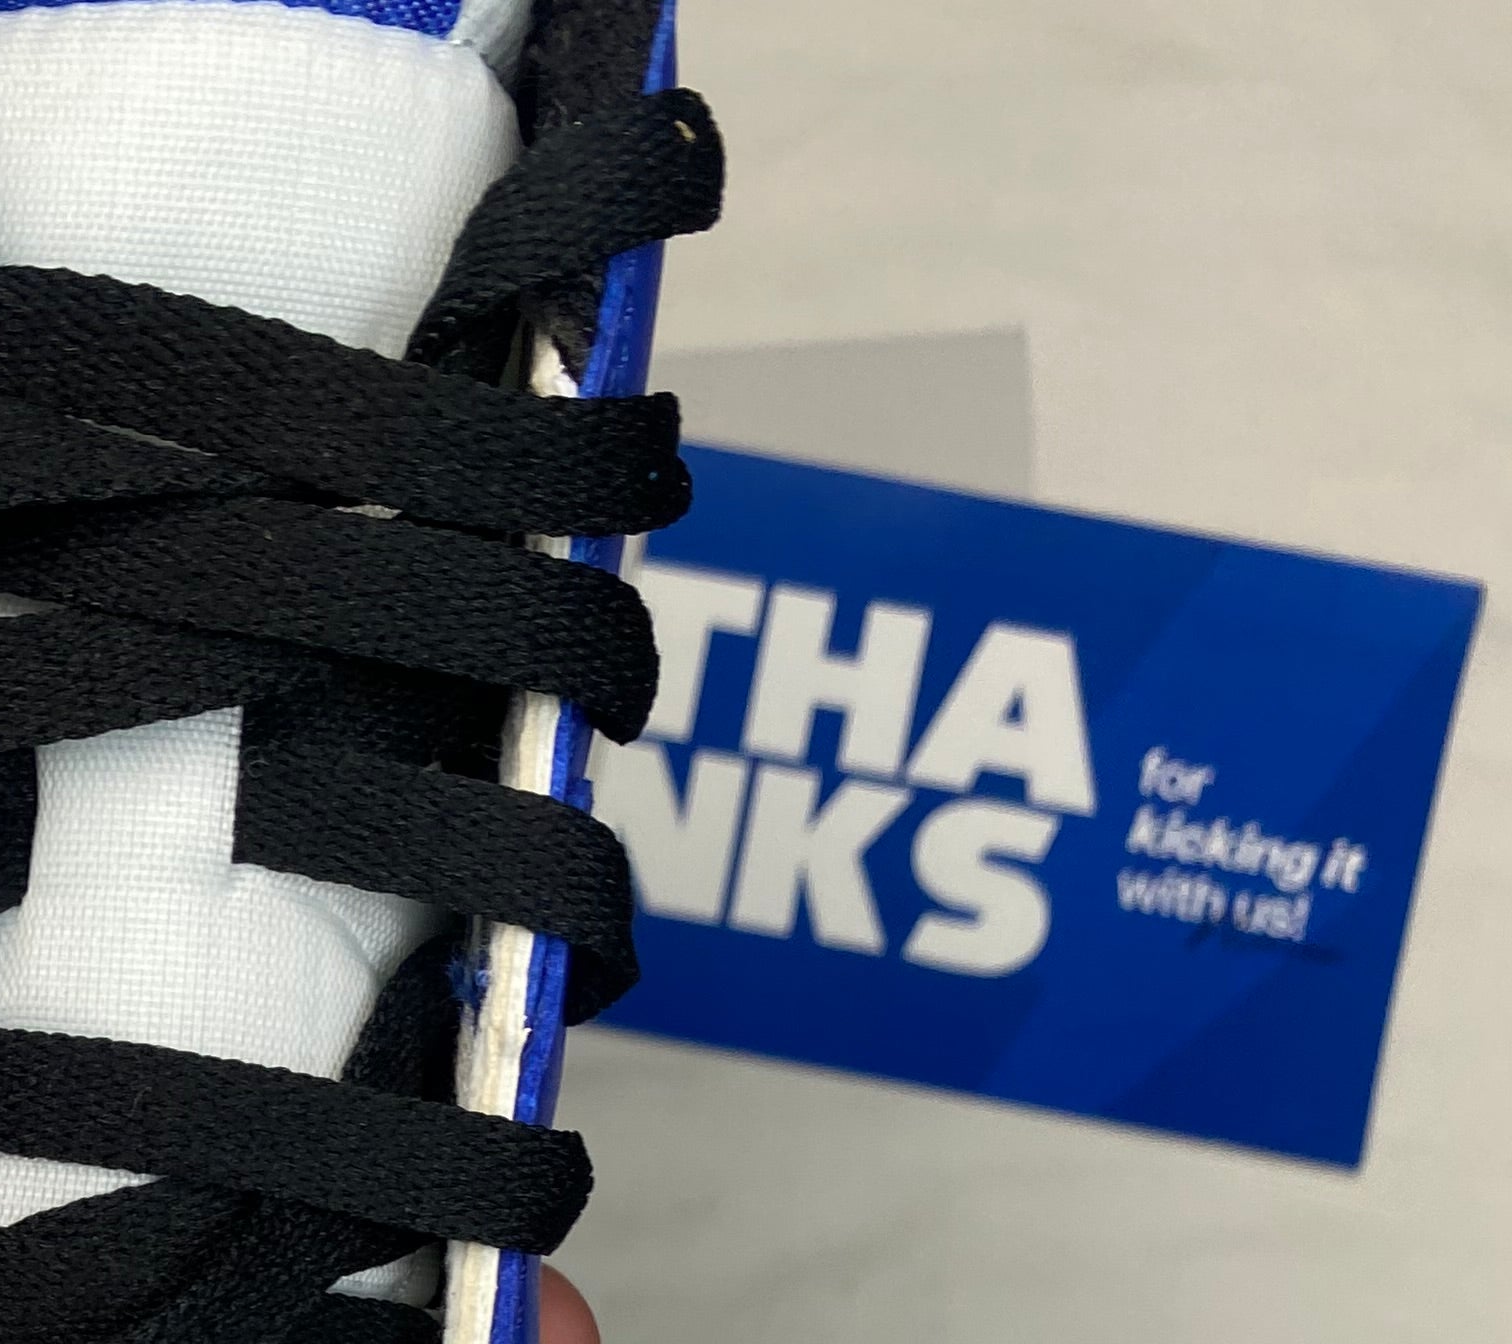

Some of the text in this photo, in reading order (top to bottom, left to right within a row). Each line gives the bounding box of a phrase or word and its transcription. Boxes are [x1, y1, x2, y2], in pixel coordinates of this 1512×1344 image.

[637, 562, 1096, 818] THA
[1140, 745, 1215, 805] for
[591, 738, 1060, 980] NKS
[1125, 803, 1366, 893] kicking it
[1117, 867, 1311, 941] with us!
